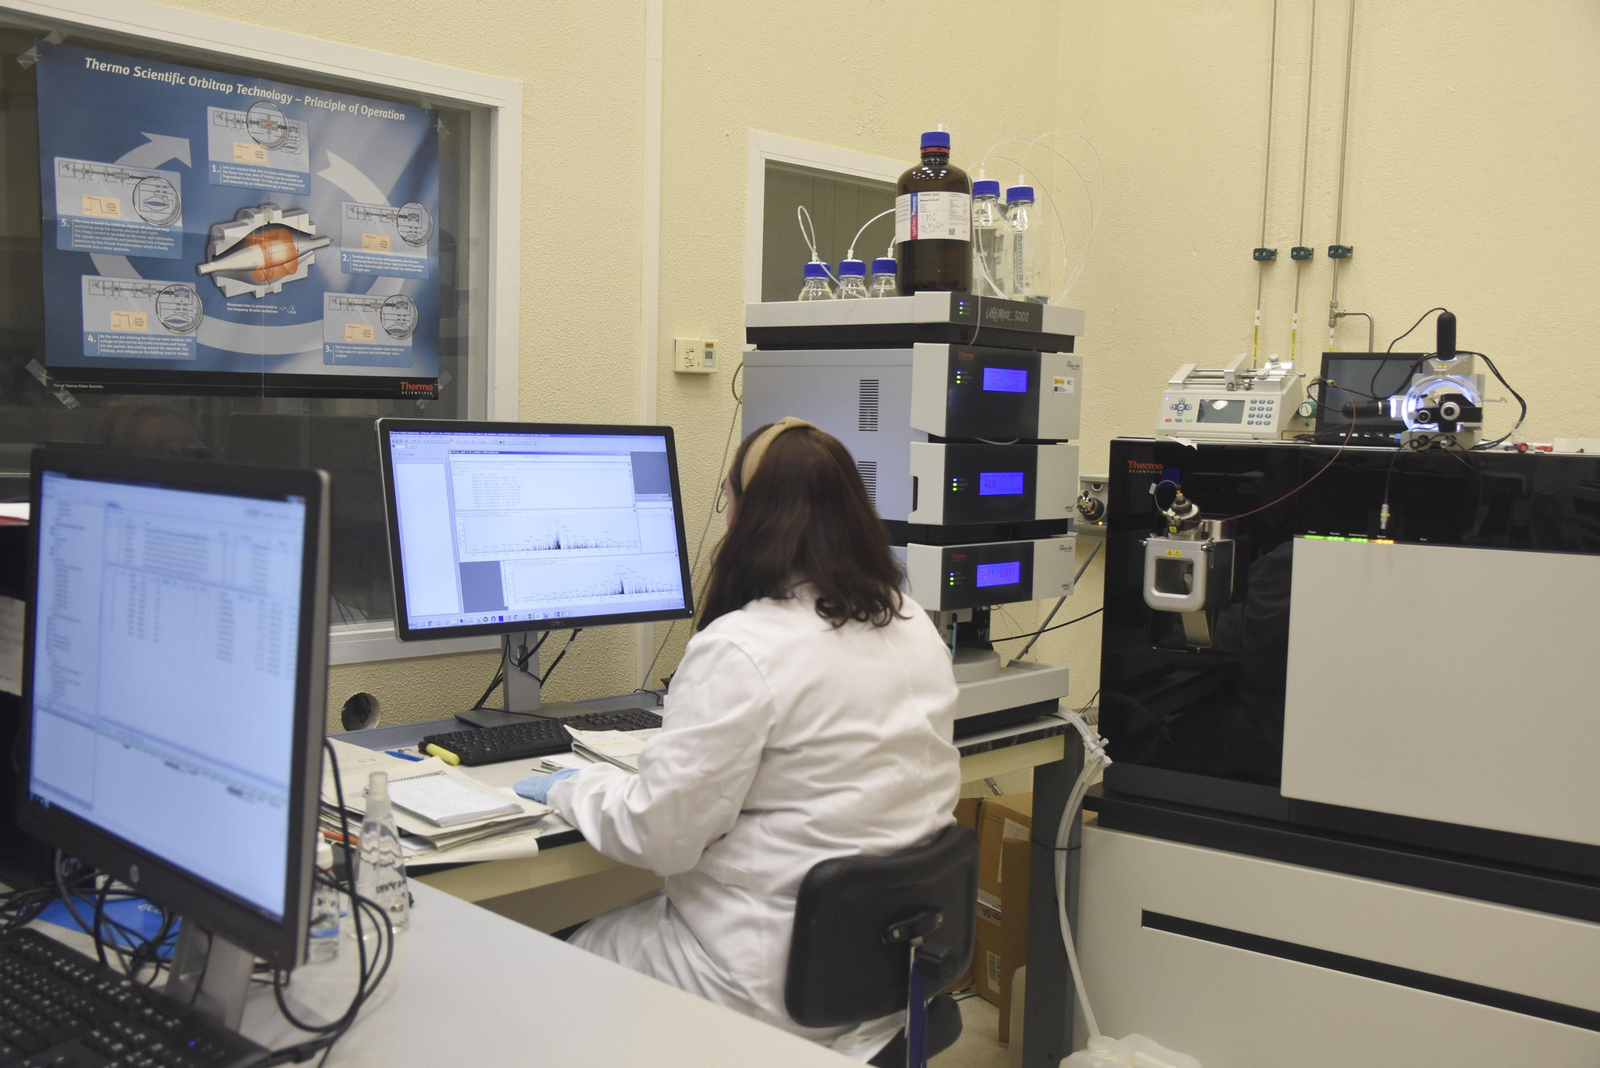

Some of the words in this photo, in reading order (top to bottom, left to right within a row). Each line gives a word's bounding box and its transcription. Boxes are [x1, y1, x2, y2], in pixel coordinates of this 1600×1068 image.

[85, 58, 129, 75] Thermo
[134, 66, 185, 85] Scientific
[189, 75, 233, 94] Orbitrap
[236, 82, 293, 104] Technology
[304, 96, 346, 112] Principle
[349, 102, 359, 114] of
[360, 105, 405, 121] Operation
[211, 164, 219, 172] 1.
[62, 218, 70, 227] 5.
[1014, 310, 1029, 322] 3000
[400, 382, 434, 390] Thermo
[1128, 460, 1163, 470] Thermo
